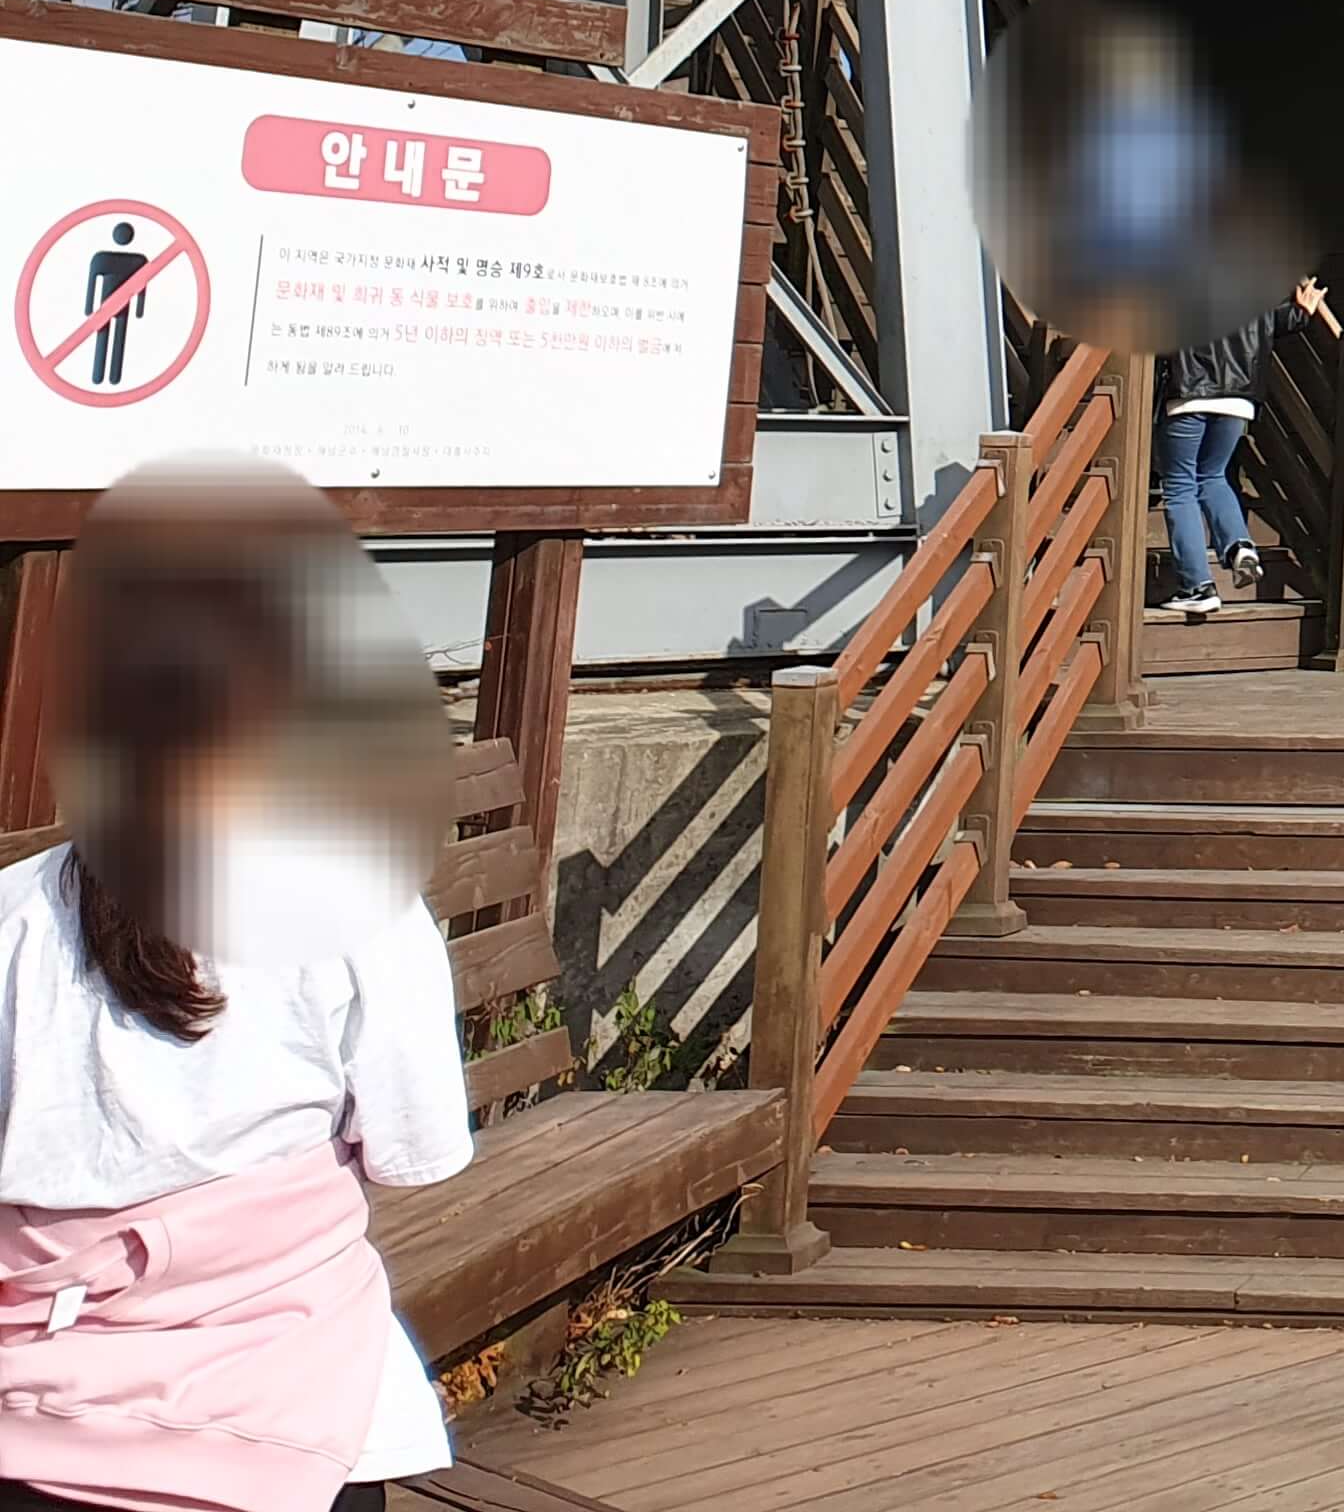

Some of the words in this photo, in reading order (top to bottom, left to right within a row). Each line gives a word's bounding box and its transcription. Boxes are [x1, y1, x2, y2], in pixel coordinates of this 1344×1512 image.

[320, 130, 486, 203] 안내문
[280, 247, 290, 261] 이
[295, 248, 329, 264] 지역은
[335, 251, 379, 269] 국가지정
[421, 255, 449, 274] 사적
[456, 257, 468, 275] 및
[476, 259, 503, 278] 명승
[275, 280, 324, 302] 문화재
[331, 284, 345, 303] 및
[352, 285, 383, 305] 희귀
[410, 288, 440, 309] 식물
[447, 290, 484, 311] 보호를
[271, 322, 282, 337] 는
[287, 323, 311, 338] 동법
[368, 328, 390, 342] 의거
[394, 323, 418, 343] 5년
[425, 326, 469, 344] 이하의
[474, 328, 502, 347] 징역
[509, 330, 536, 348] 또는
[595, 334, 632, 352] 이하의
